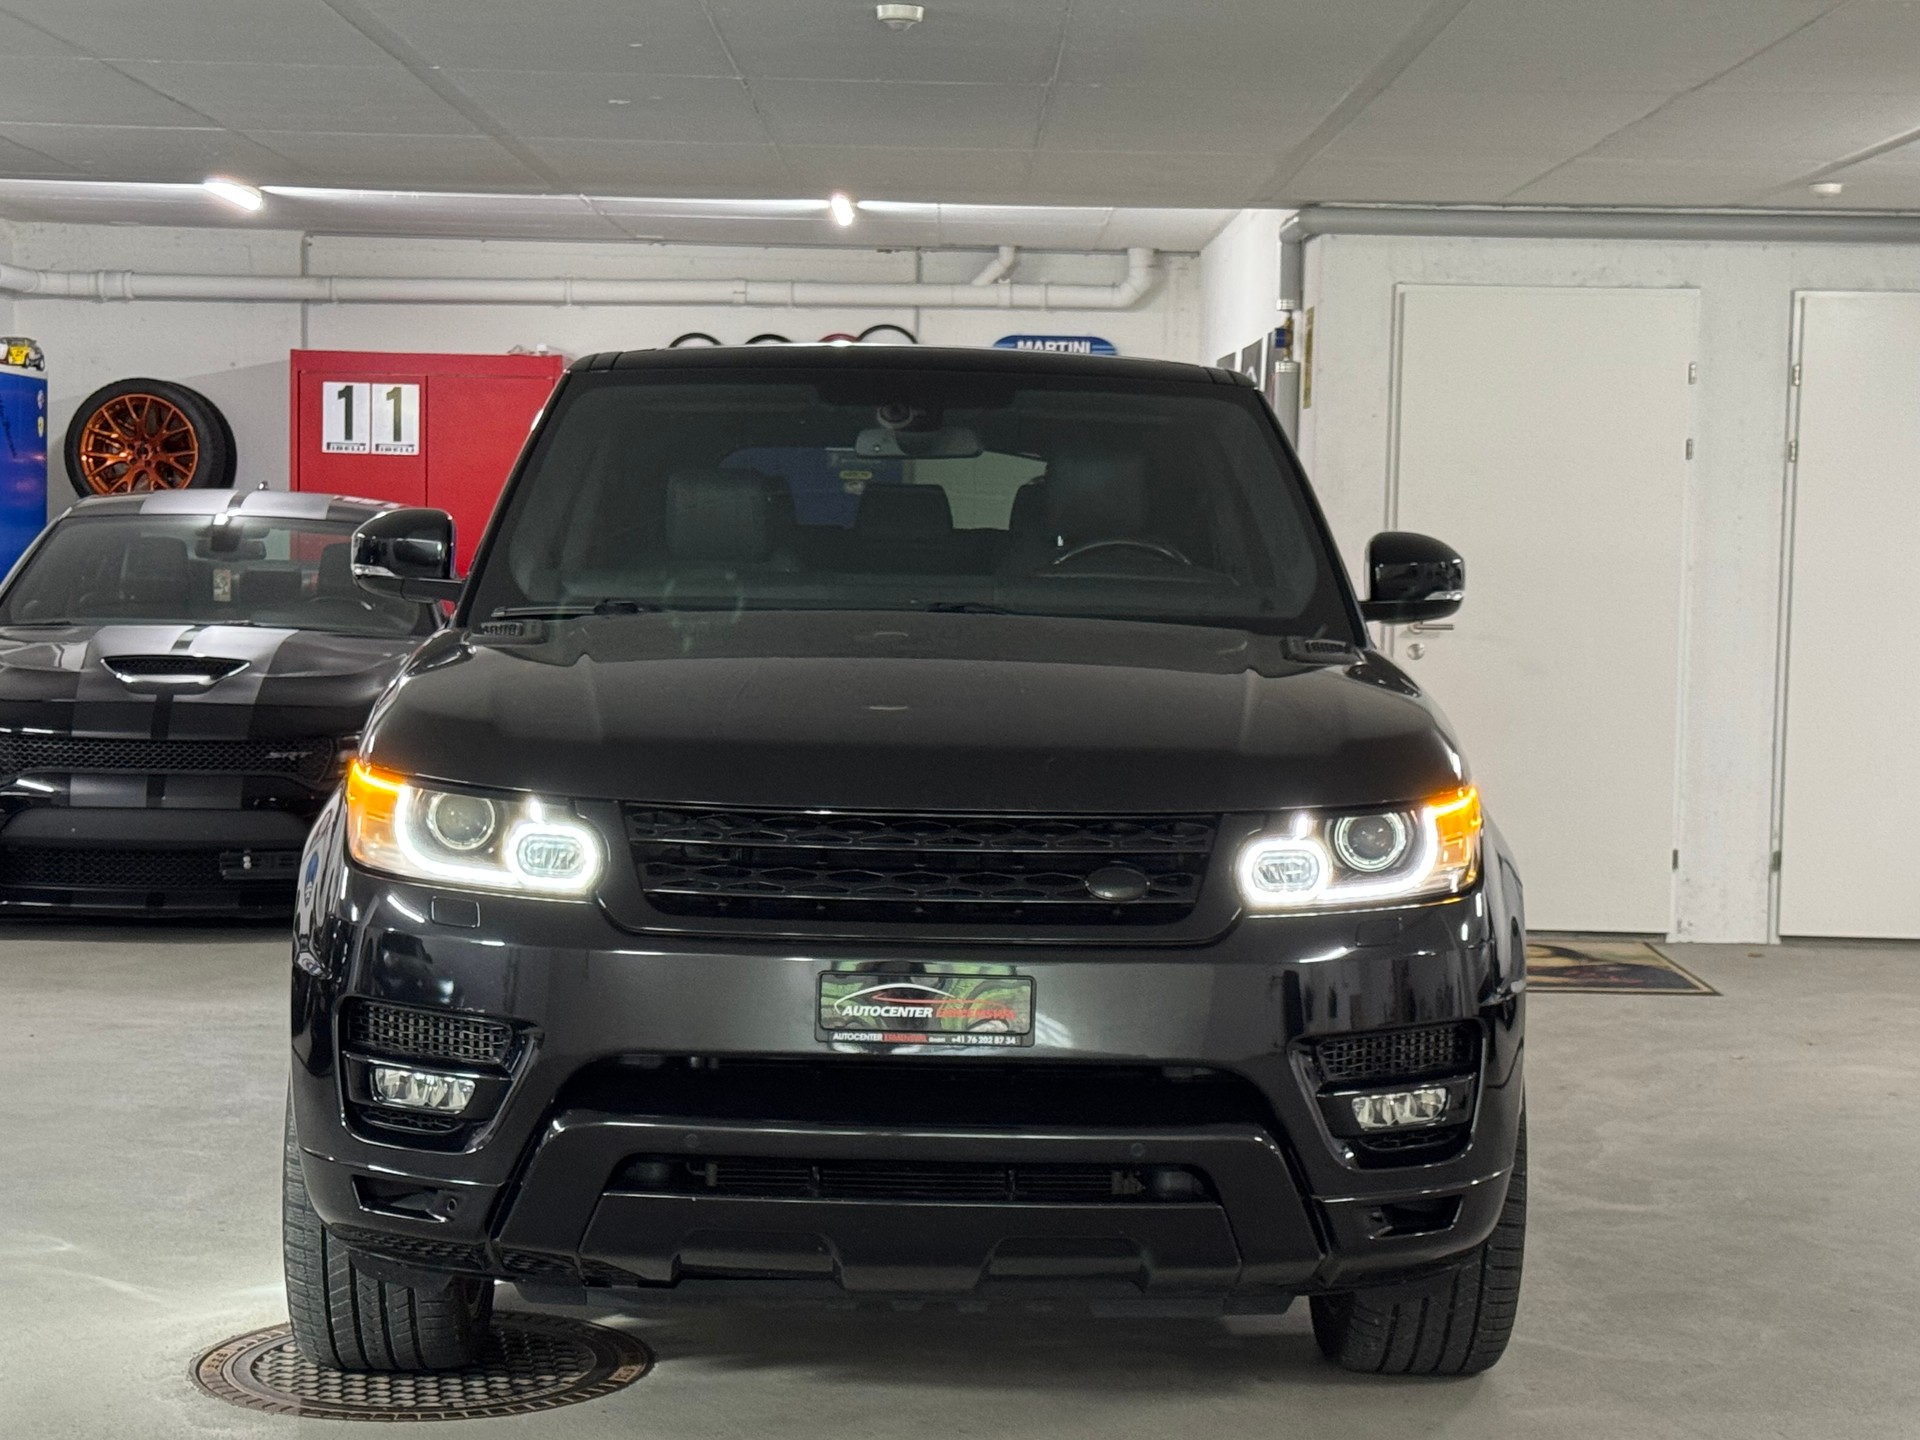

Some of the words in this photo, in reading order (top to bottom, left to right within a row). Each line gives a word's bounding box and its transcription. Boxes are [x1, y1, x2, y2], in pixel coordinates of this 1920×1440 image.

[1017, 341, 1092, 354] MARTINI
[842, 1005, 933, 1018] AUTOCENTER
[832, 1032, 884, 1042] AUTOCENTER
[967, 1035, 978, 1044] 76
[978, 1035, 993, 1044] 202
[1005, 1036, 1017, 1045] 34
